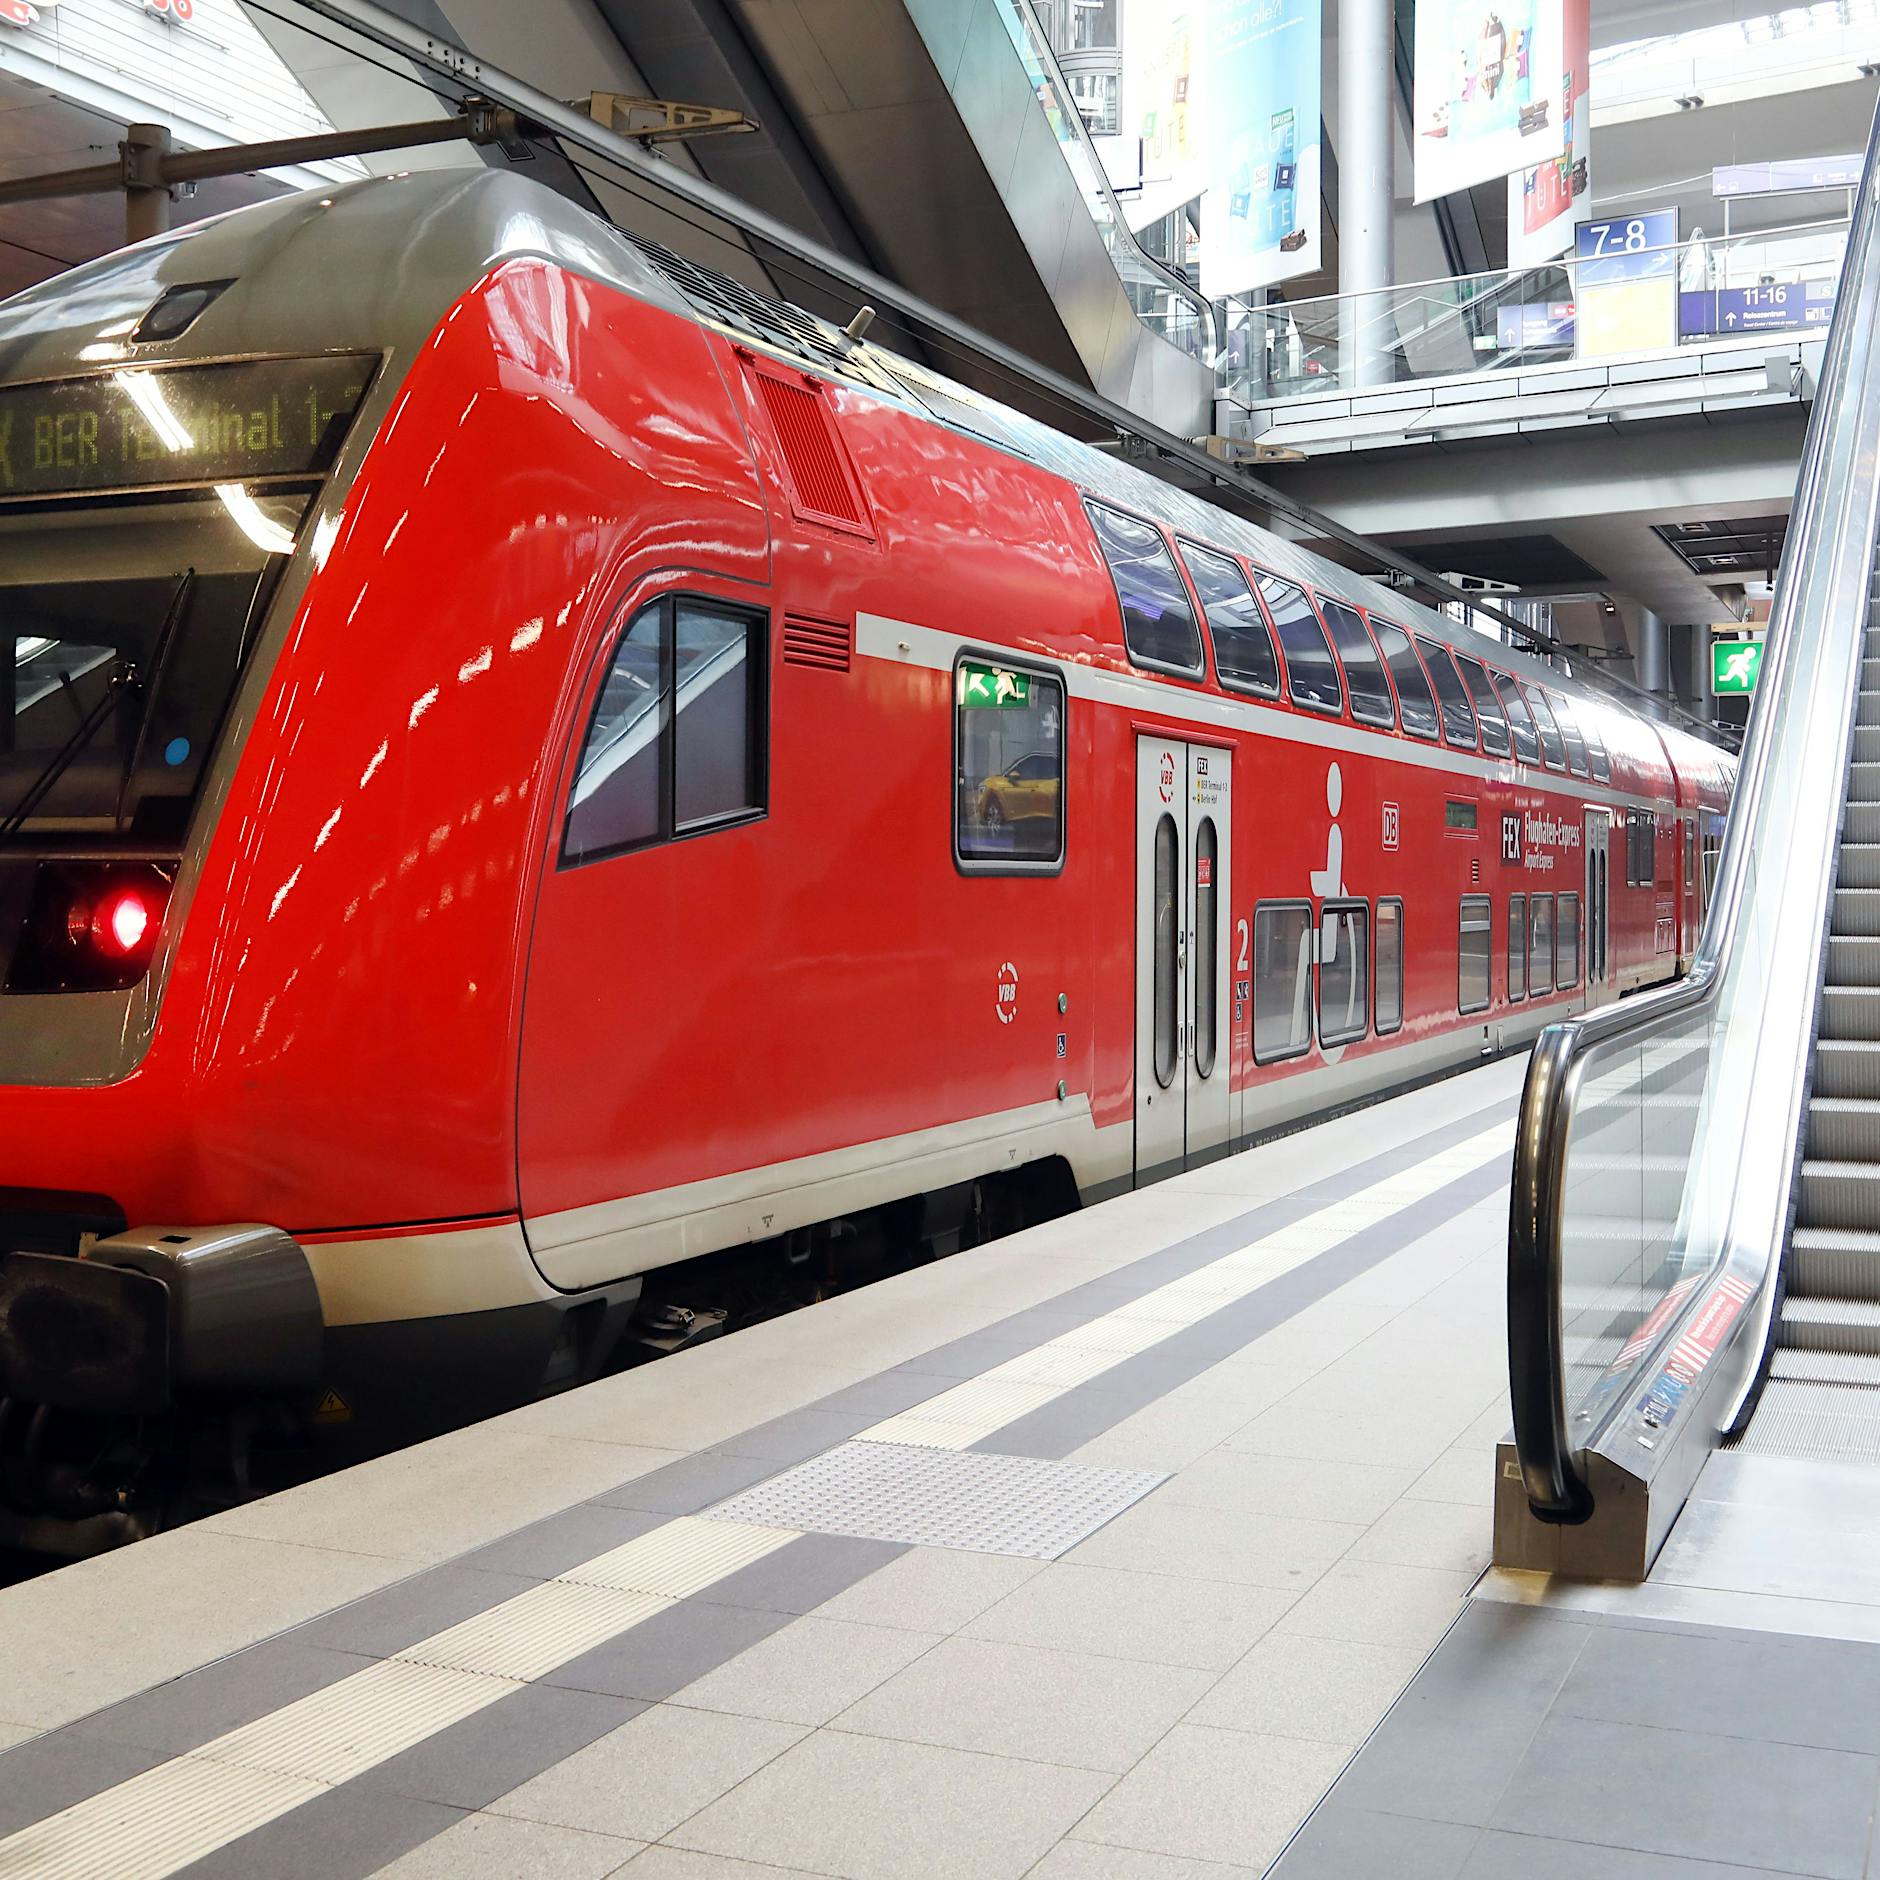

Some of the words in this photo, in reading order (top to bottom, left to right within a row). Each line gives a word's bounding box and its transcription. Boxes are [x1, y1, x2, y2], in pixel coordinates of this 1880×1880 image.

[1590, 219, 1647, 257] 7-8
[1743, 286, 1787, 306] 11-16
[34, 410, 98, 469] BER
[117, 391, 285, 462] Teminal
[1160, 770, 1173, 785] VBB
[1198, 759, 1208, 773] FEX
[1384, 808, 1397, 844] DB
[1503, 816, 1520, 859] FEX
[1524, 810, 1580, 854] Flughafen-Express
[1524, 849, 1540, 873] Airport
[1540, 850, 1554, 874] Express
[1236, 918, 1249, 972] 2
[999, 983, 1016, 1003] VBB
